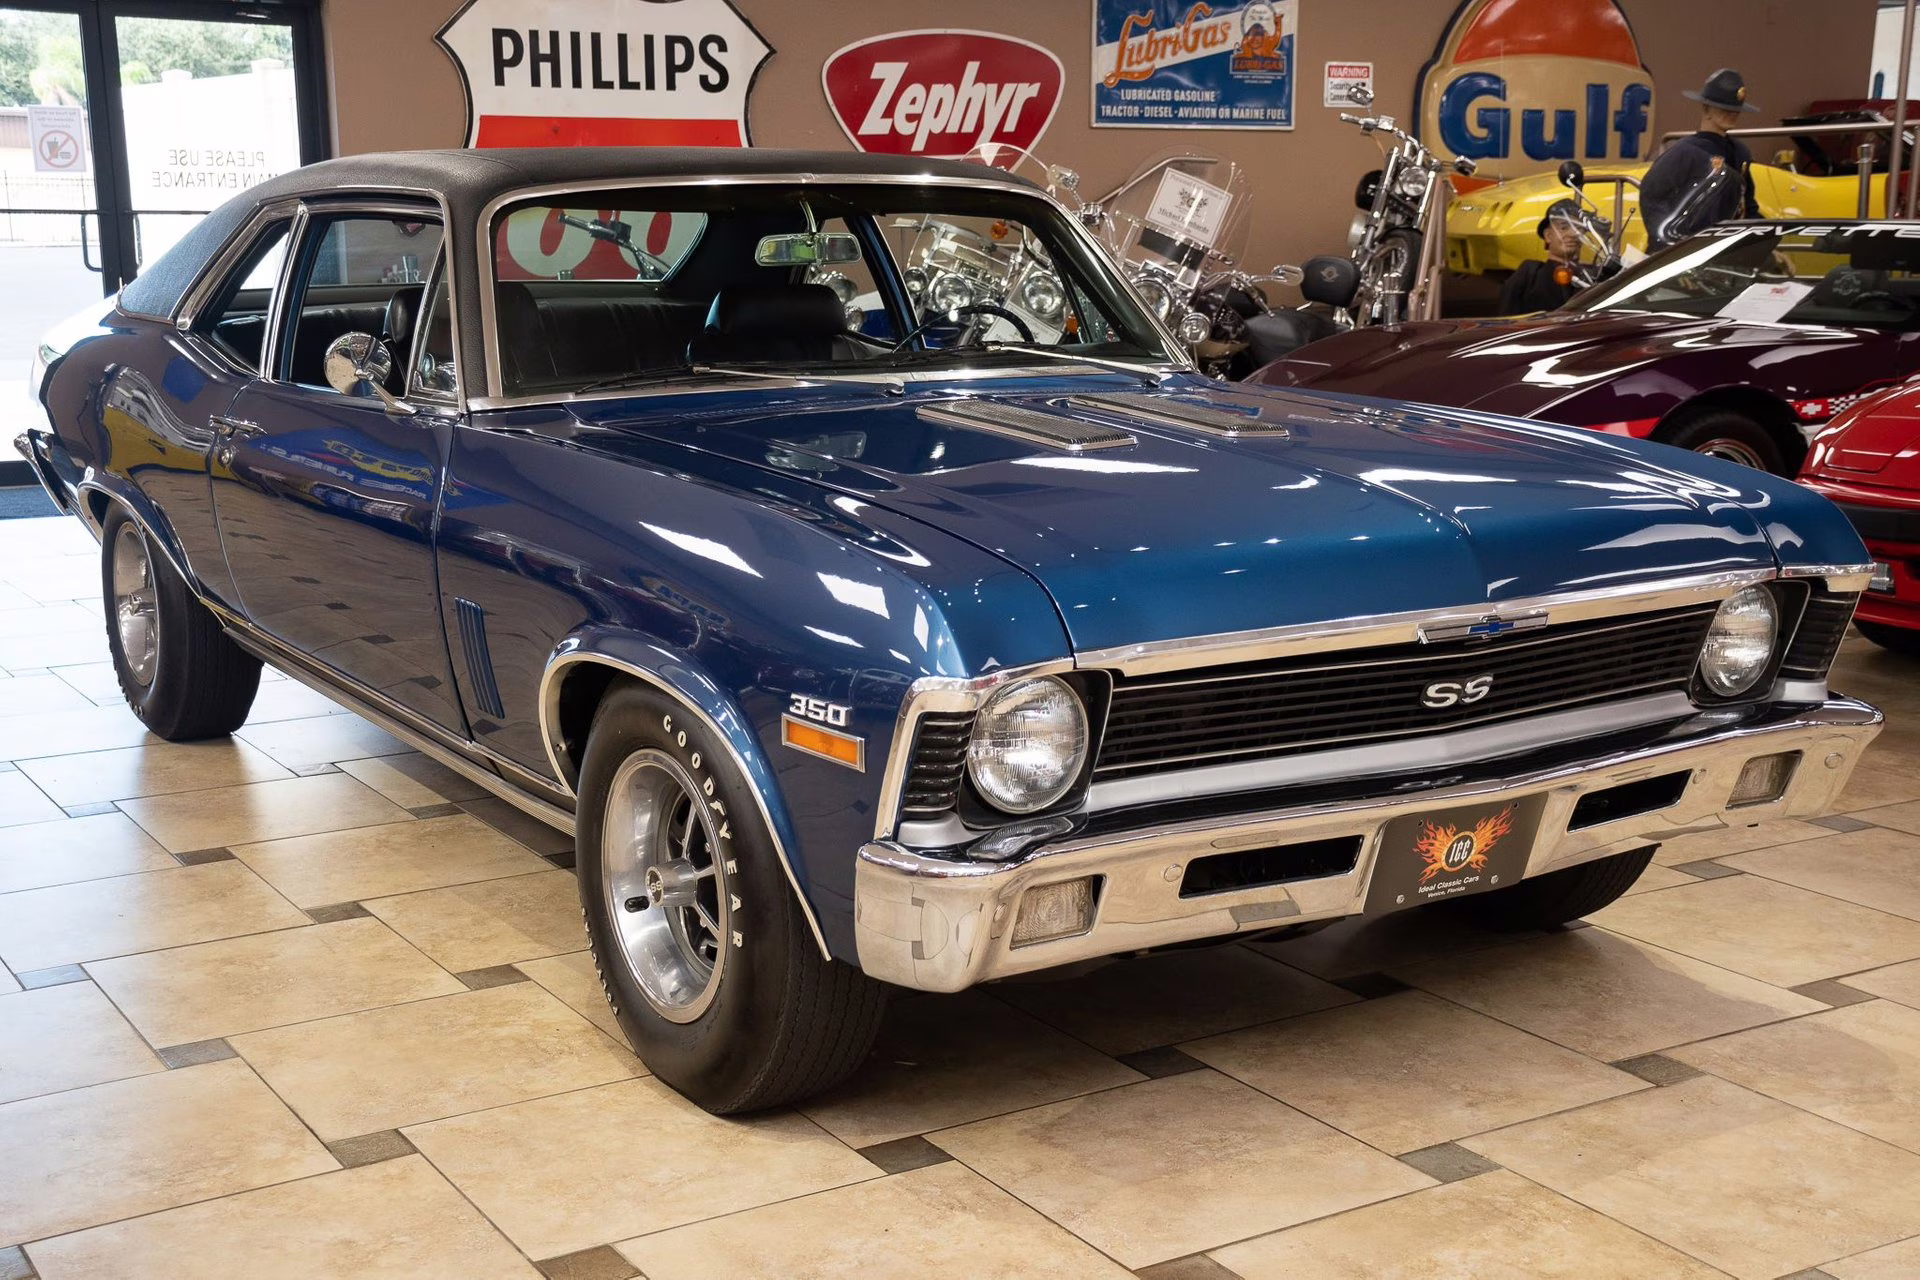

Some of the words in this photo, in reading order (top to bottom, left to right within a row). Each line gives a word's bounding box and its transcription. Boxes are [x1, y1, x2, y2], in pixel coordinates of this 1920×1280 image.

[492, 28, 729, 93] PHILLIPS
[1329, 67, 1368, 78] WARNING
[857, 61, 1041, 152] Zephyr
[1120, 89, 1172, 101] LUBRICATED
[1174, 90, 1216, 102] GASOLINE
[1101, 105, 1139, 117] TRACTOR
[1144, 106, 1173, 118] DIESEL
[1177, 107, 1217, 119] AVIATION
[1218, 109, 1230, 119] OR
[1232, 108, 1264, 120] MARINE
[1266, 109, 1286, 120] FUEL
[1438, 72, 1652, 161] Gulf
[1694, 224, 1920, 238] CORVETTE
[1422, 676, 1494, 708] SS
[789, 693, 850, 727] 350
[663, 714, 743, 948] GOODYEAR
[1449, 839, 1471, 863] ICC
[1418, 883, 1436, 894] Ideal
[1437, 879, 1462, 890] Classic
[1463, 875, 1480, 884] Cars
[1447, 886, 1466, 894] Florida
